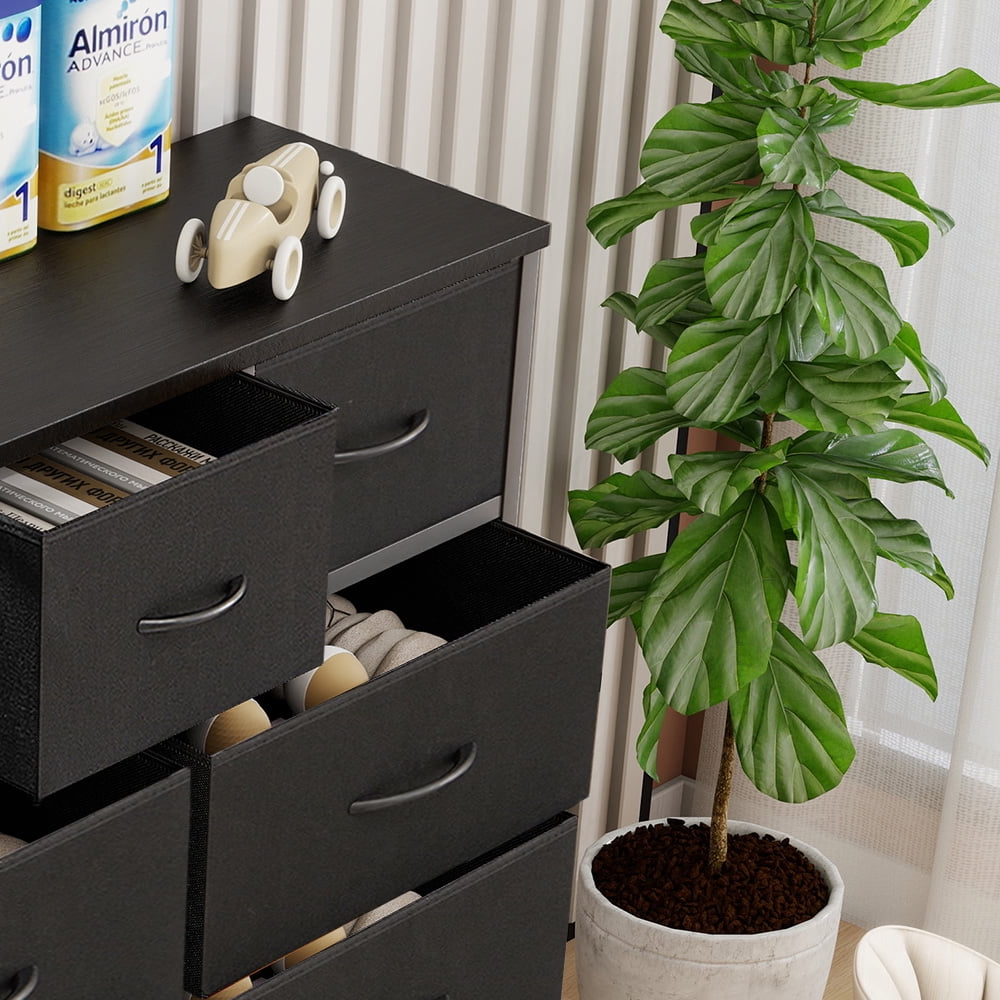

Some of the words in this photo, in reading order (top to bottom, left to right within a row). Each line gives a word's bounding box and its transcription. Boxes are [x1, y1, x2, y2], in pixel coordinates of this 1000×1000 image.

[68, 8, 168, 58] Almirón
[67, 40, 141, 74] ADVANCE
[150, 134, 163, 174] 1
[15, 181, 29, 222] 1
[64, 183, 96, 200] digest
[102, 432, 162, 460] ДРУГИХ
[23, 461, 89, 490] ДРУГИХ
